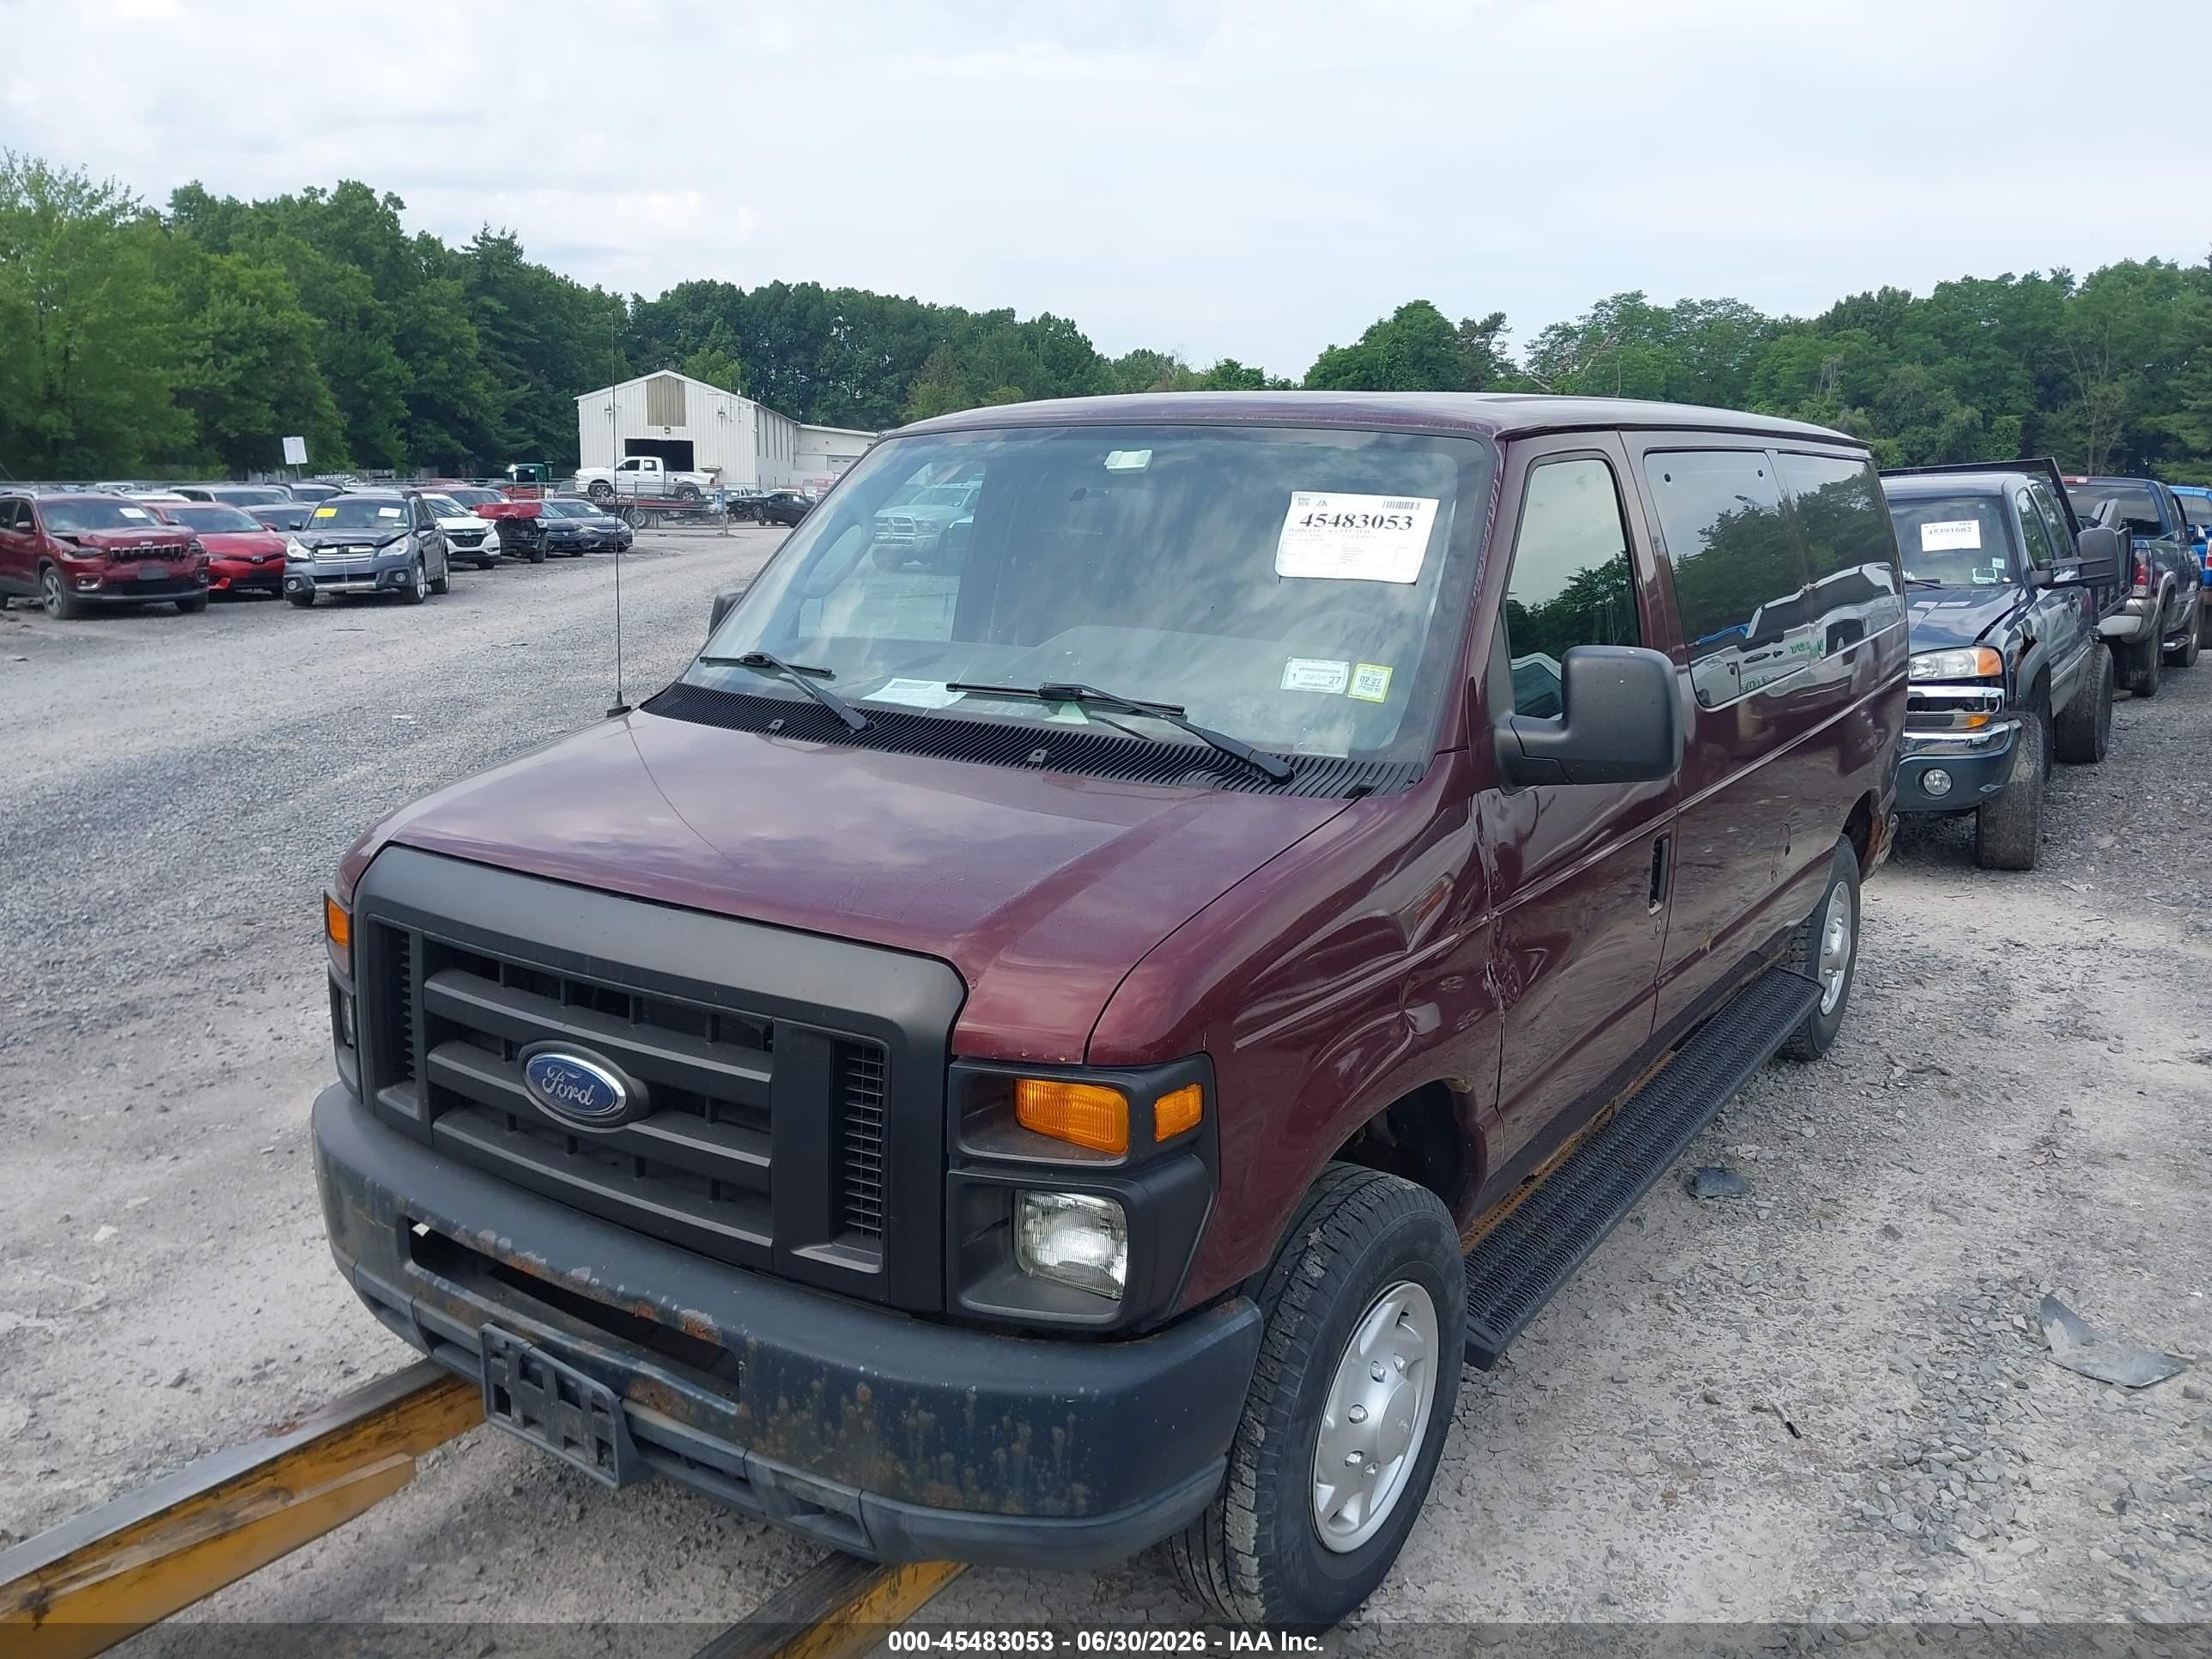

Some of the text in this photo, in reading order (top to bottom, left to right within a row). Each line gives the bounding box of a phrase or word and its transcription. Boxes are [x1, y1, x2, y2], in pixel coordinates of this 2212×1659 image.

[1299, 513, 1413, 531] 45483053
[1328, 676, 1341, 684] 27
[542, 1065, 594, 1106] Ford
